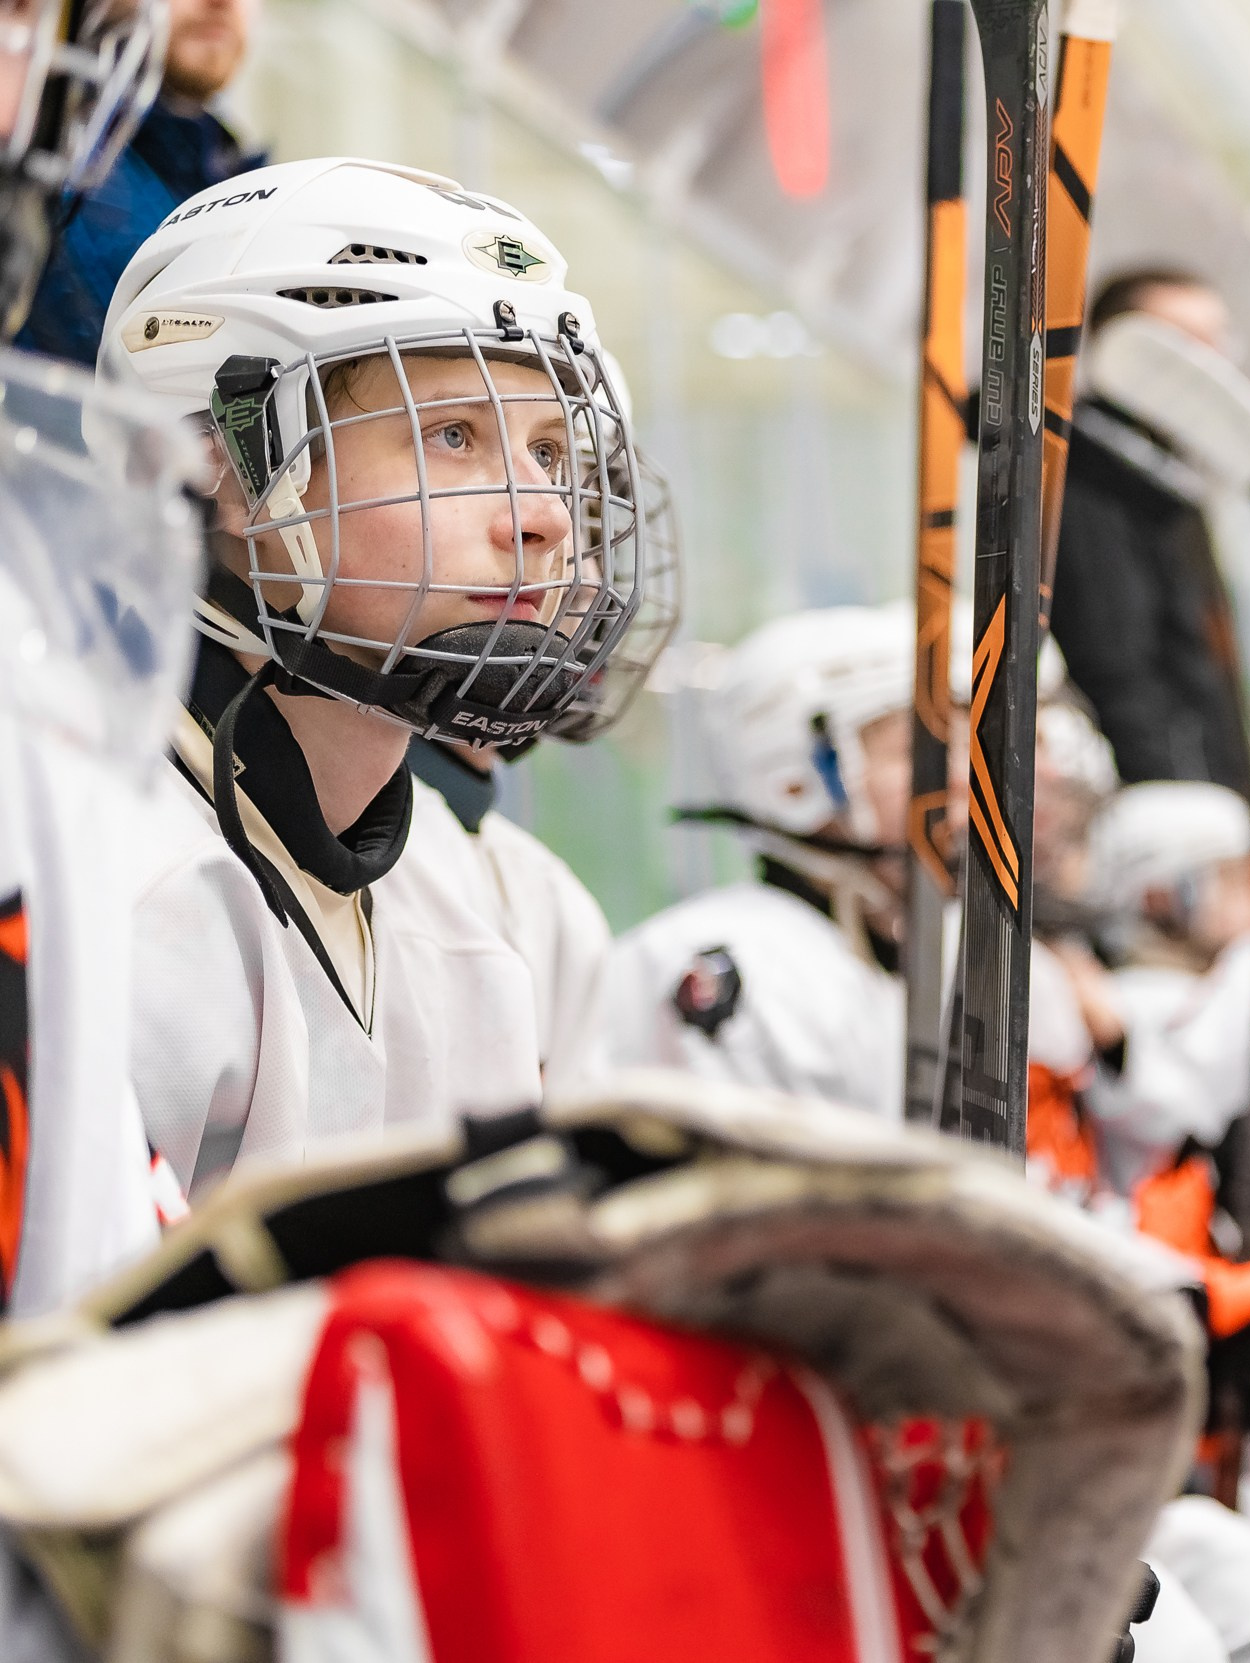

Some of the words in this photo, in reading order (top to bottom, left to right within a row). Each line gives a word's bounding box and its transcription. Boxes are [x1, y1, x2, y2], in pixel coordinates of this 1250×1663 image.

[993, 97, 1014, 239] ADV
[157, 186, 278, 231] ASTON
[1031, 347, 1040, 418] SERIES
[451, 710, 549, 737] EASTON
